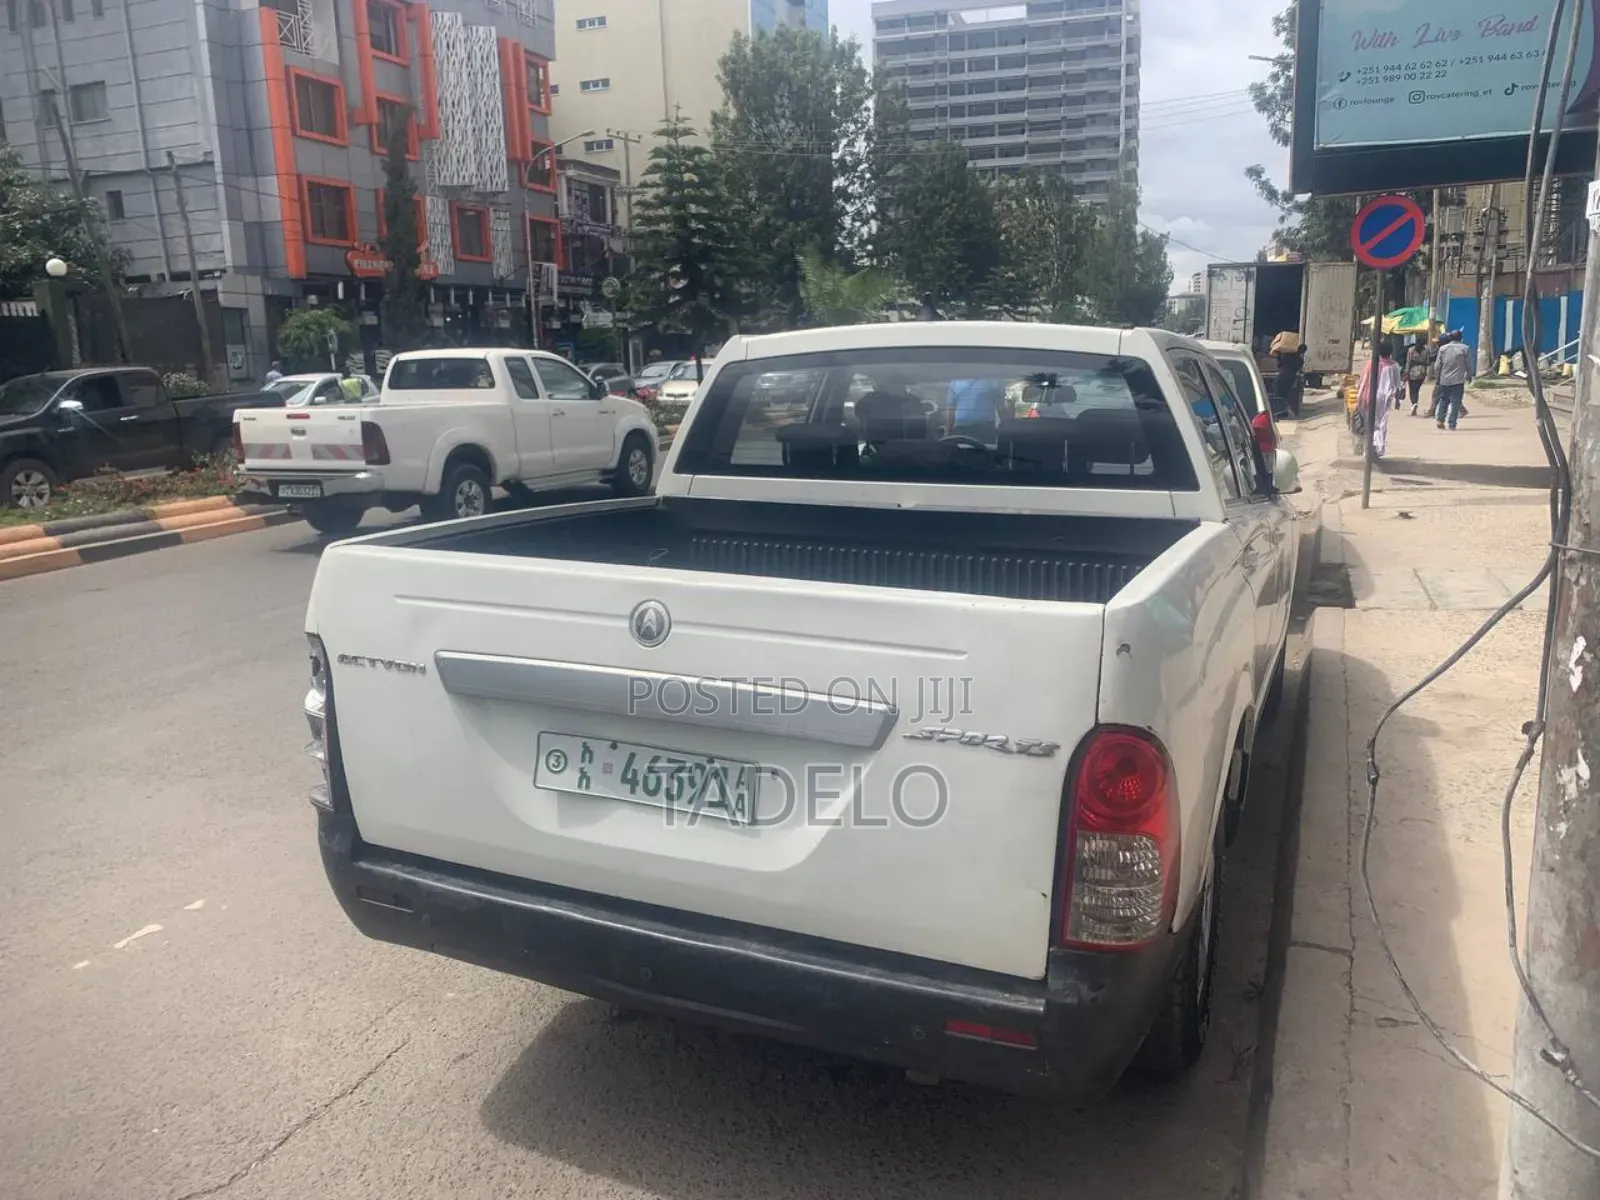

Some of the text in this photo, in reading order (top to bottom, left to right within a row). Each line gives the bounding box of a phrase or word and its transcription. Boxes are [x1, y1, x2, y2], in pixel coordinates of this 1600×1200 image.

[1351, 14, 1539, 52] With Live Band
[1357, 66, 1380, 75] +251
[1383, 64, 1402, 72] 944
[1404, 62, 1417, 71] 62
[1420, 61, 1432, 69] 62
[1435, 59, 1448, 68] 62
[1459, 56, 1484, 65] +251
[1487, 54, 1507, 62] 944
[1510, 51, 1523, 60] 63
[1526, 49, 1540, 58] 63
[1356, 70, 1447, 86] +251 989 00 22 22
